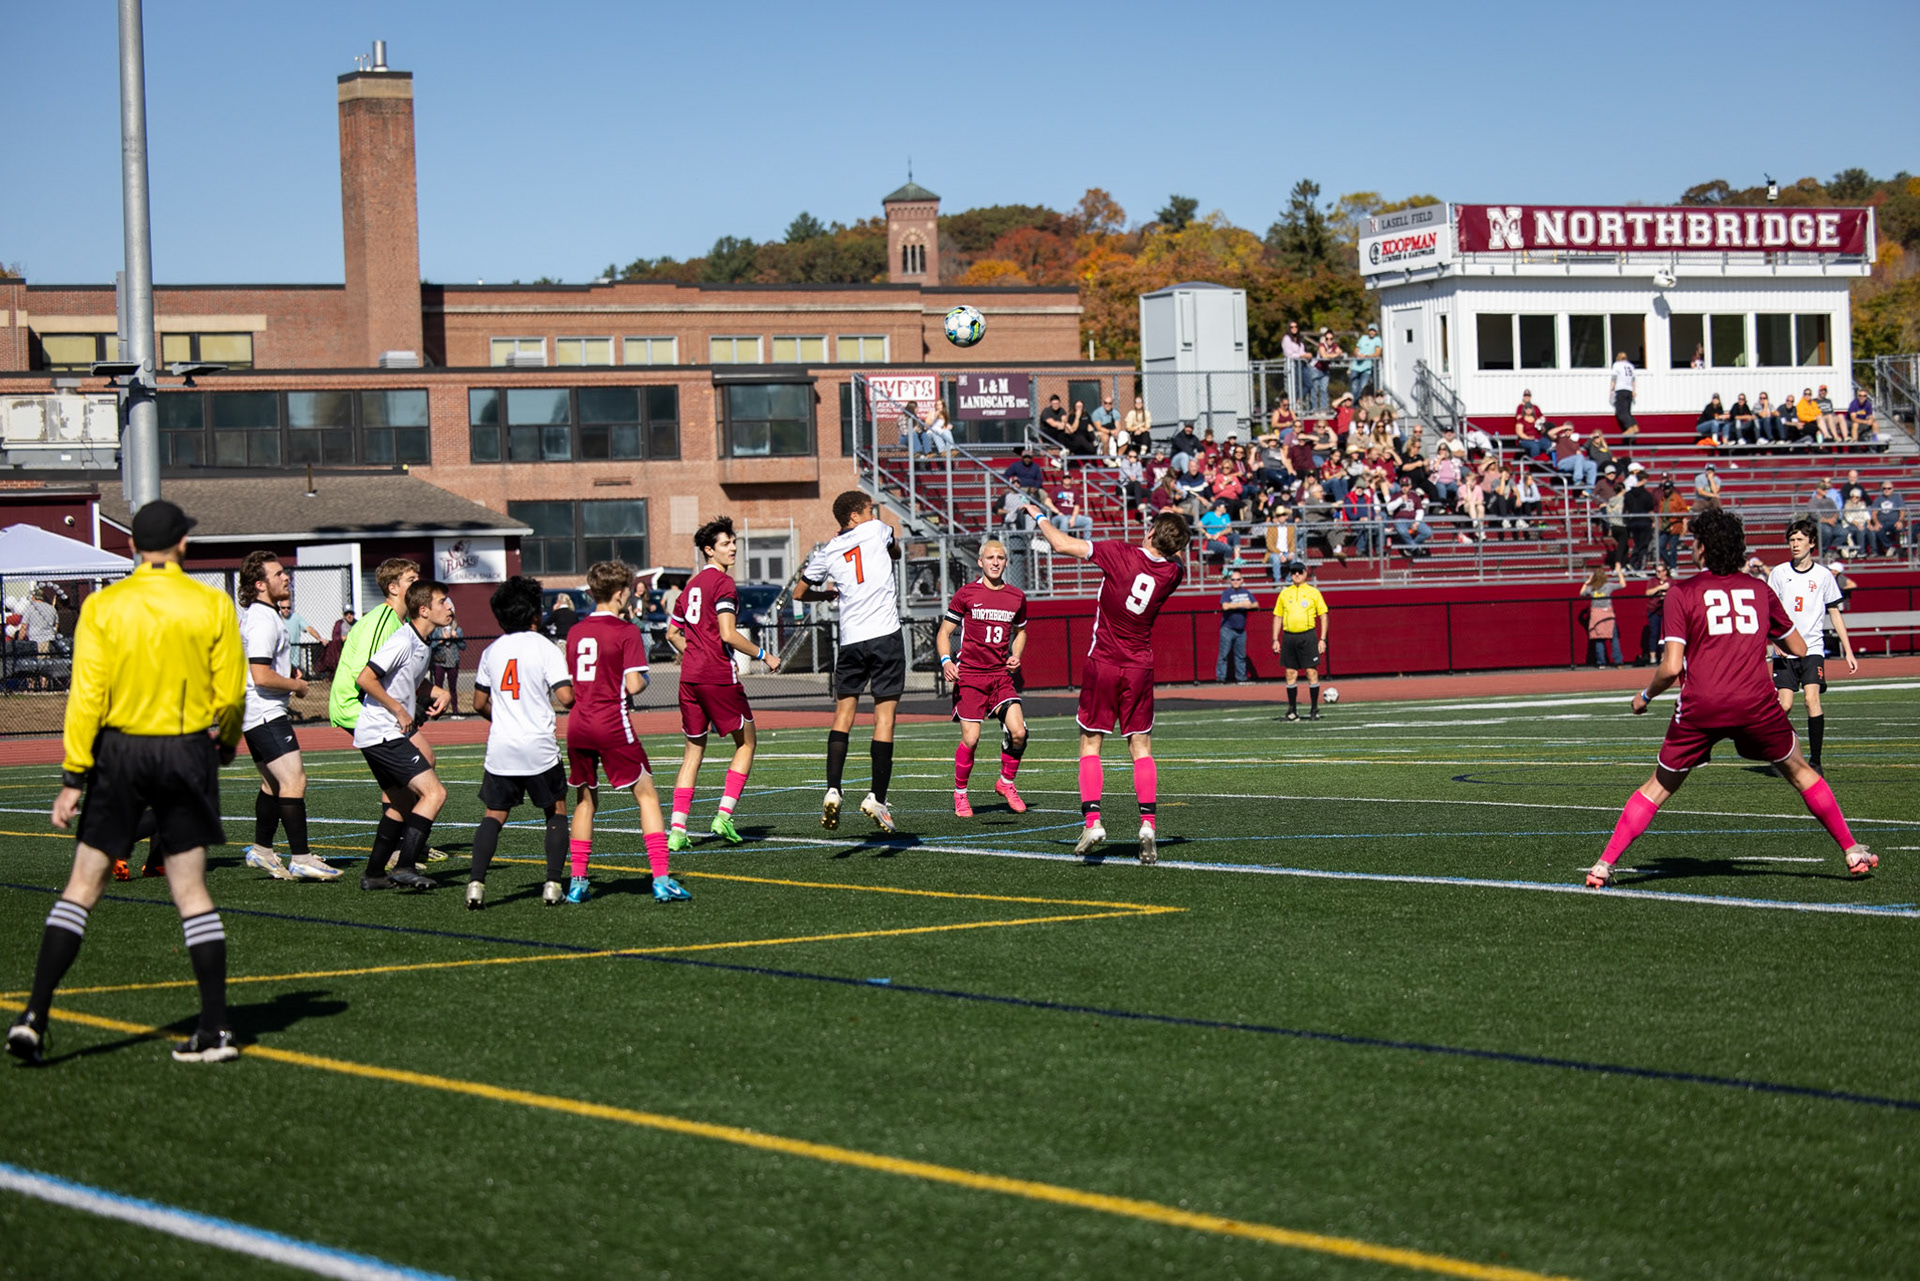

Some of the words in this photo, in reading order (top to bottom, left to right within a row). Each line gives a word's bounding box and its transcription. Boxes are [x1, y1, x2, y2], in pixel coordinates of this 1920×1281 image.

[1381, 218, 1409, 229] LASELL
[1411, 211, 1433, 224] FIELD
[1533, 210, 1841, 248] NORTHBRIDGE
[1381, 232, 1437, 255] KOOPMAN
[960, 395, 1015, 409] LANDSCAPE
[978, 378, 987, 394] L
[988, 379, 998, 394] &
[998, 378, 1009, 394] M
[842, 545, 866, 584] 7
[685, 587, 702, 624] 8
[1125, 573, 1156, 615] 9
[1703, 588, 1760, 635] 25
[1794, 596, 1803, 612] 3
[985, 626, 1003, 643] 13
[576, 637, 598, 682] 2
[500, 658, 521, 700] 4
